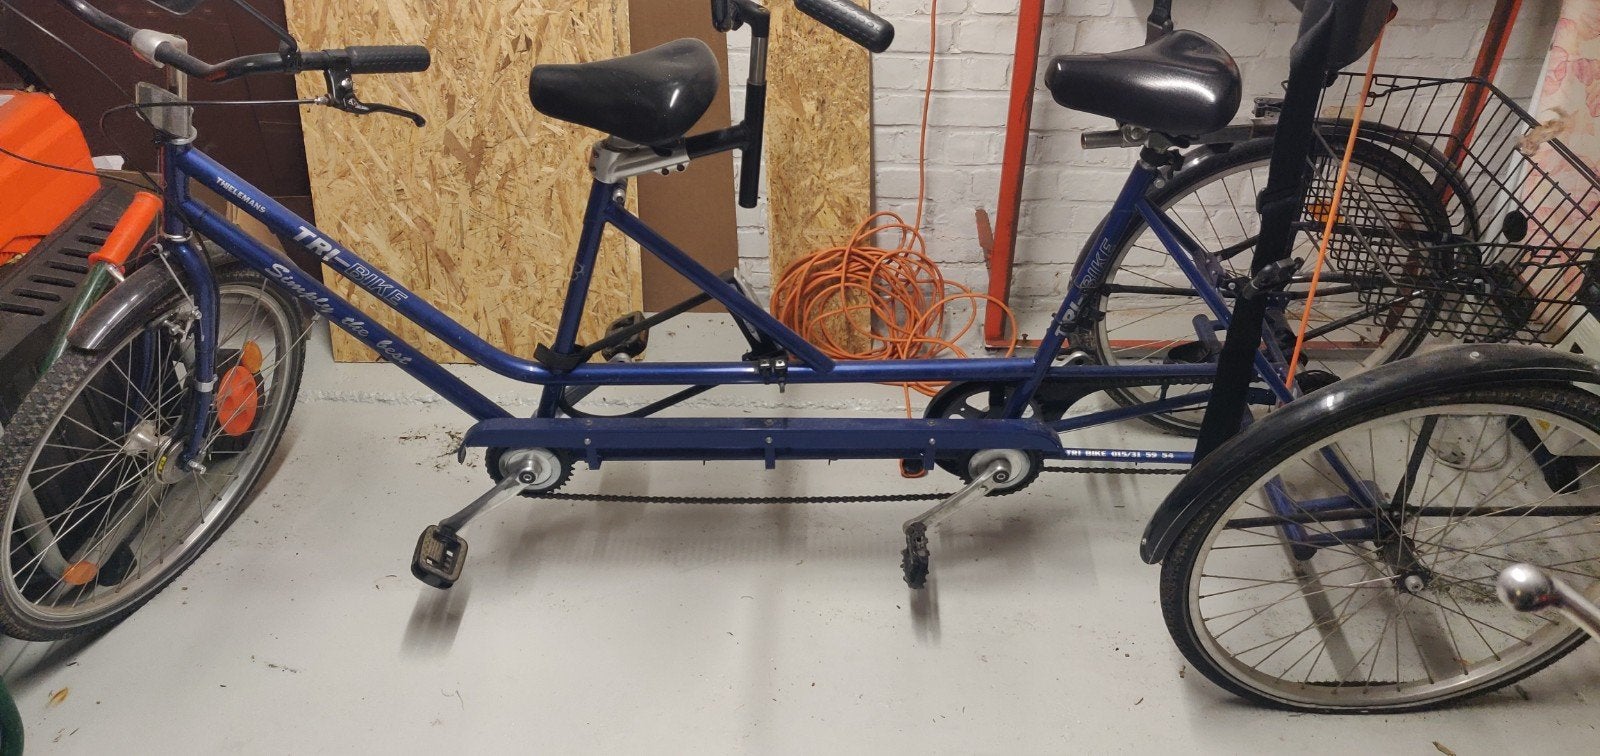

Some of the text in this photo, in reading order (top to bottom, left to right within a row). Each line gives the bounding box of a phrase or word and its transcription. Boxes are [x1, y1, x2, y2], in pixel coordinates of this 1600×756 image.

[216, 177, 267, 213] THIELEMANS
[293, 225, 409, 306] TRI-BIKE
[265, 263, 412, 365] Simply the best
